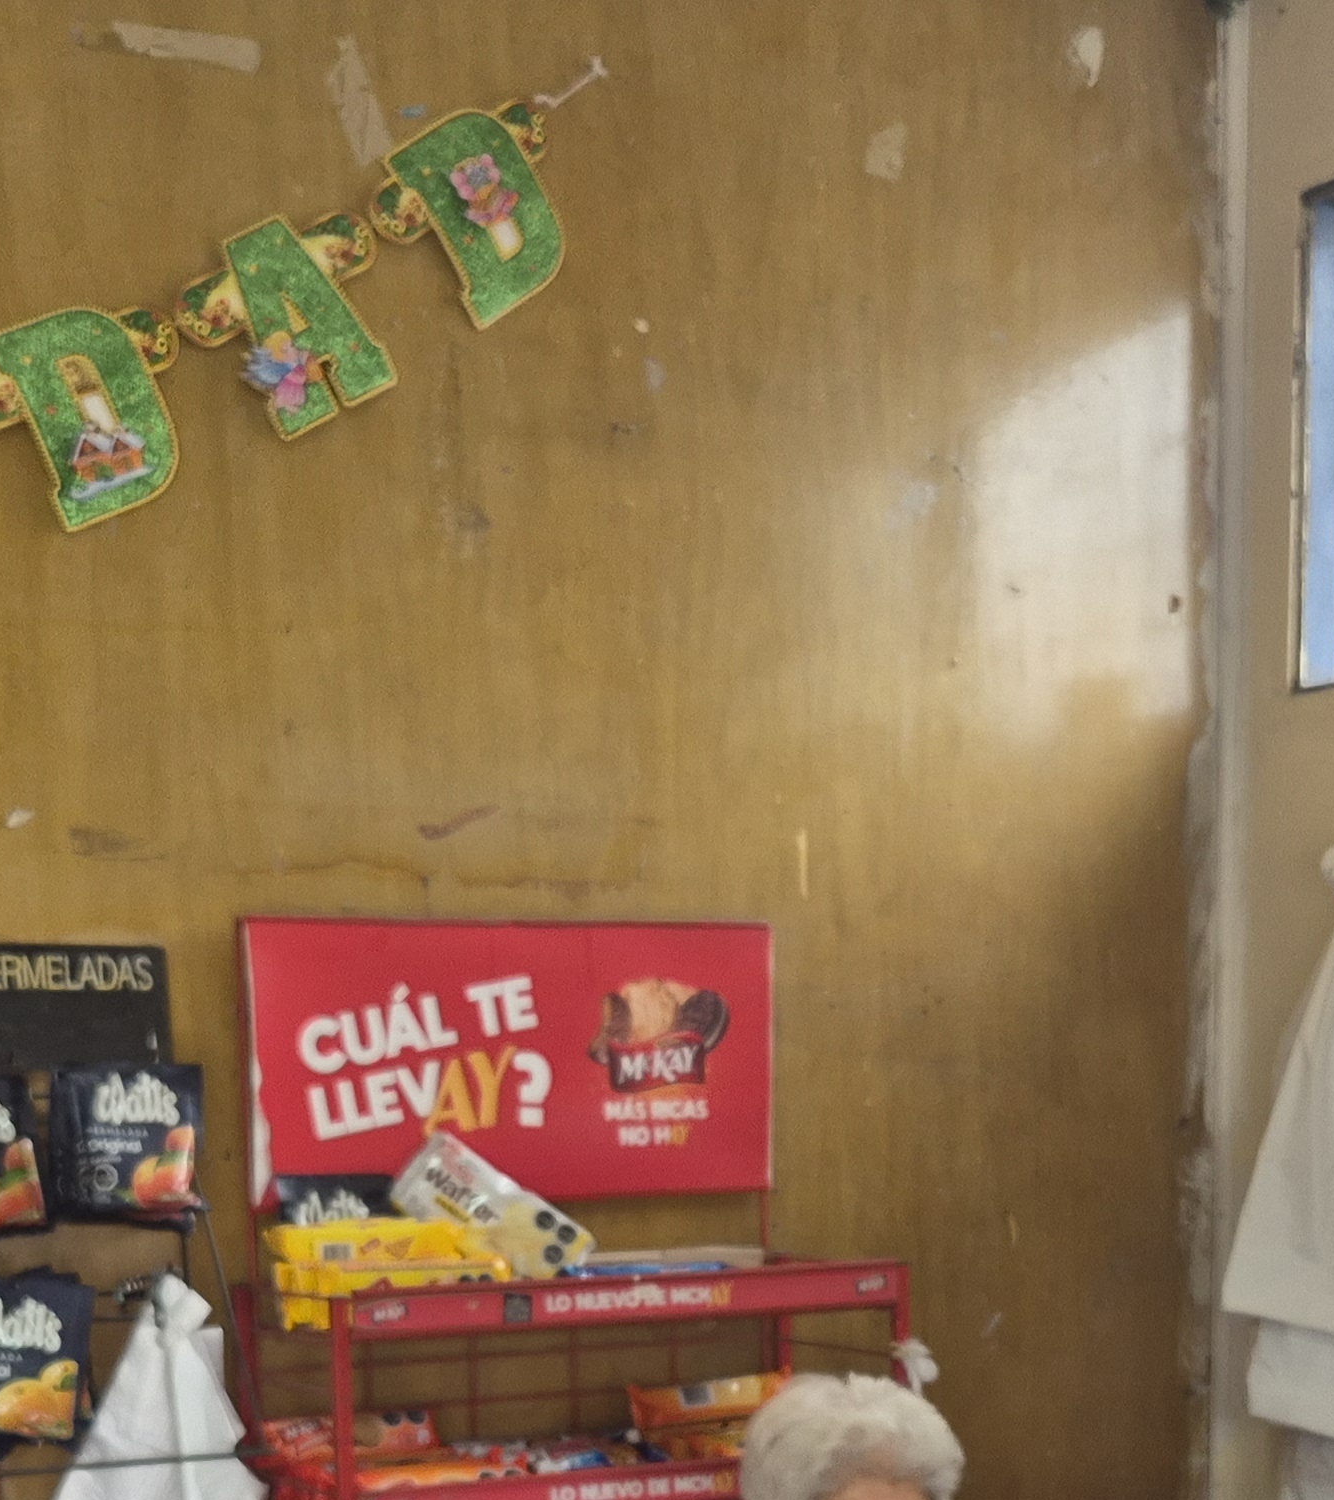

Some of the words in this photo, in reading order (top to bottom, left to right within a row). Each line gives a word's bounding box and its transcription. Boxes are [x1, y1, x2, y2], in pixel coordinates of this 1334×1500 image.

[300, 983, 458, 1074] CUÁL
[465, 974, 540, 1038] TE
[306, 1043, 553, 1142] LLEVAY?
[618, 1124, 651, 1147] NO
